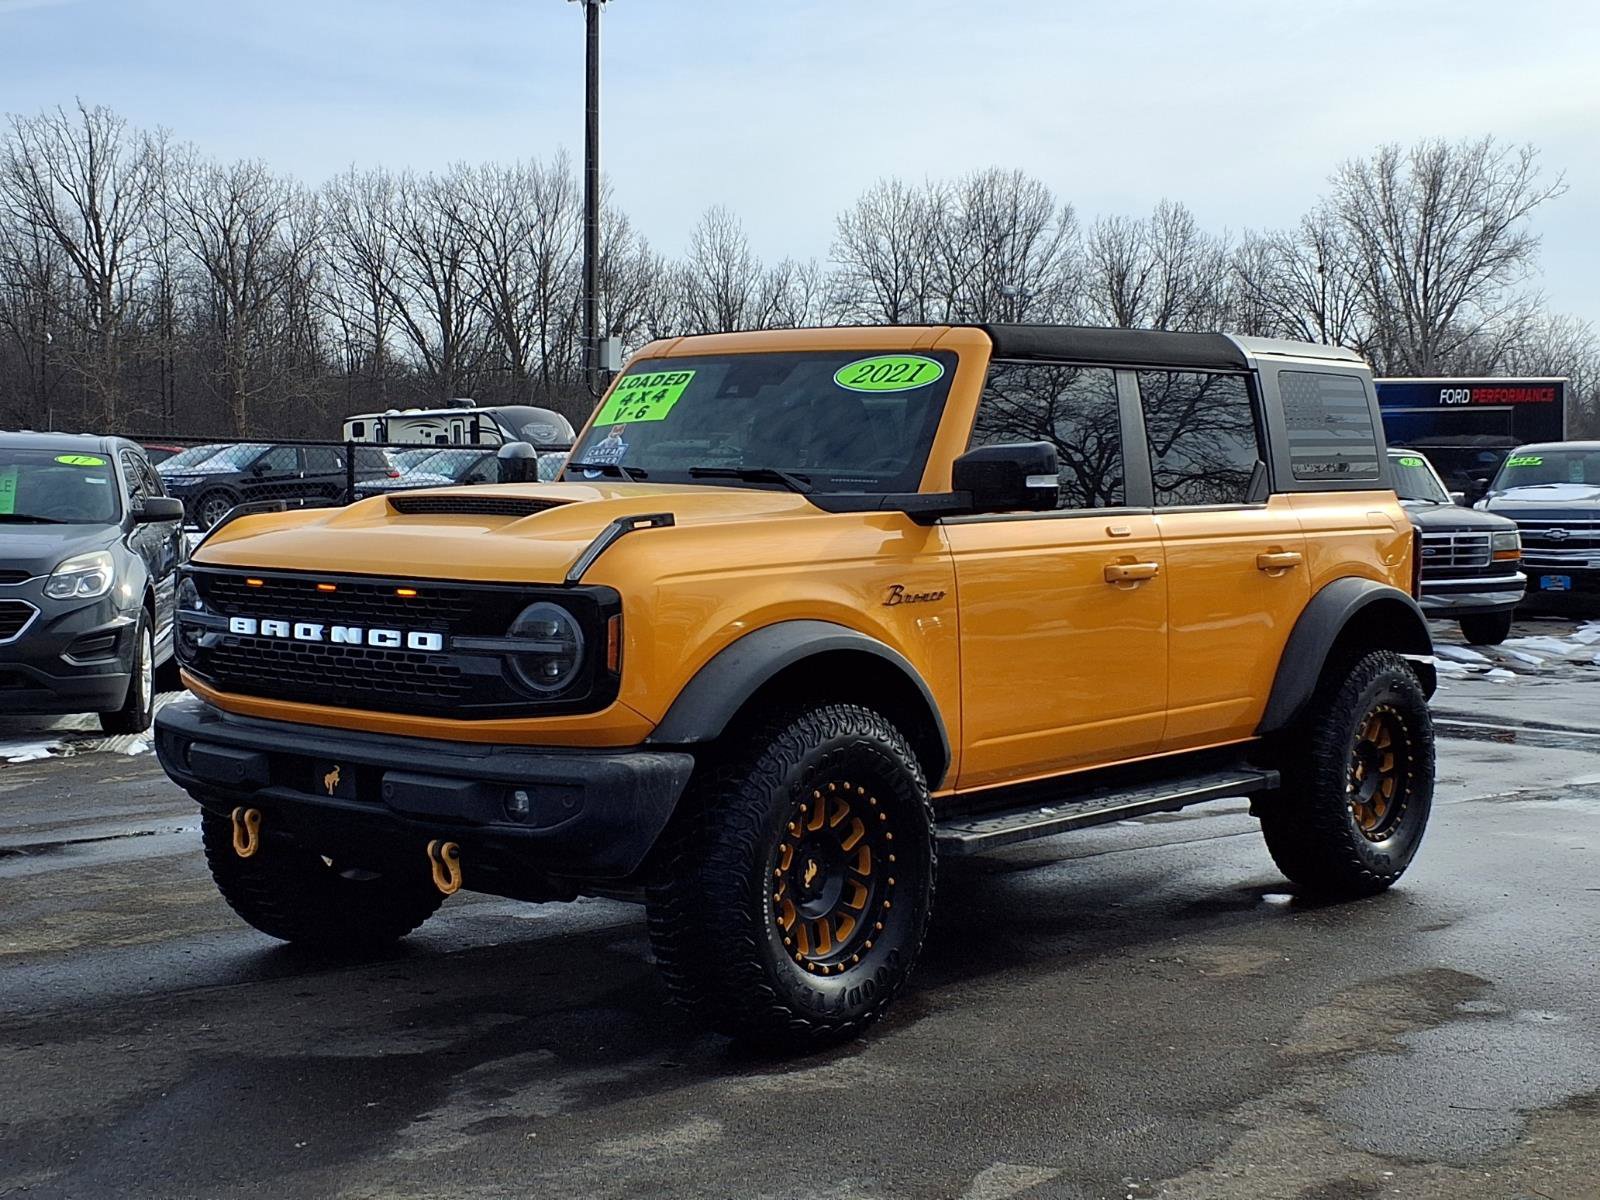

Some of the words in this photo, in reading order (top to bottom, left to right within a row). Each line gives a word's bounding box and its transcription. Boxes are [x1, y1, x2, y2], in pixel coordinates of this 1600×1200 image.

[617, 373, 690, 391] LOADED
[849, 363, 927, 384] 2021
[1439, 389, 1470, 404] FORD
[1472, 388, 1555, 404] PERFORMANCE
[613, 405, 650, 422] V-6
[882, 585, 946, 606] Bronco
[229, 617, 443, 650] BRONCO
